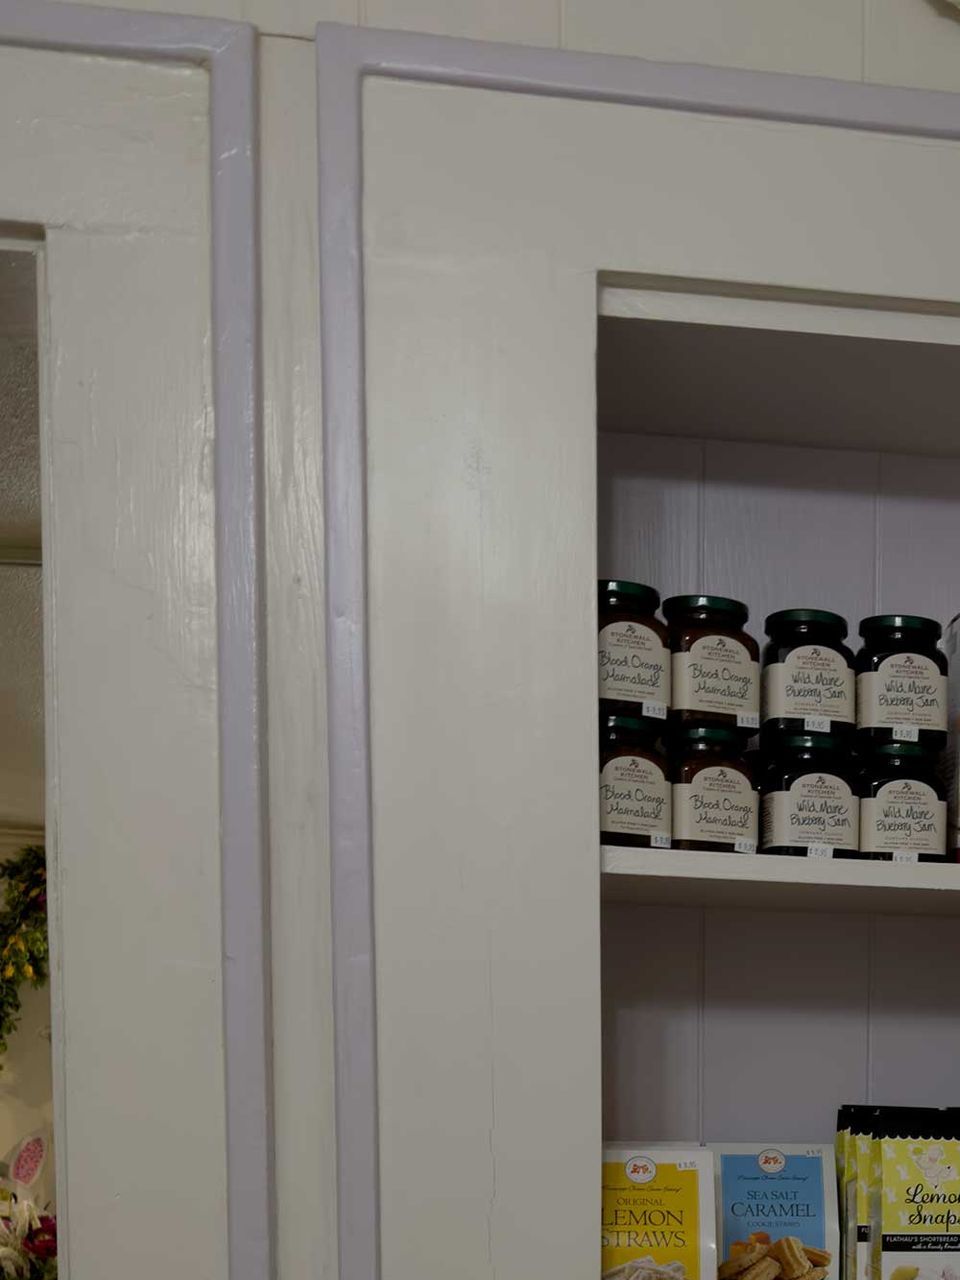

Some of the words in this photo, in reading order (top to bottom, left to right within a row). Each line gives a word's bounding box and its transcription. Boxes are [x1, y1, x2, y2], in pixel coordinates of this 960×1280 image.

[747, 1190, 769, 1200] SEA
[771, 1190, 800, 1200] SALT
[617, 1198, 664, 1206] ORIGINAL
[731, 1201, 816, 1217] CARAMEL
[601, 1208, 684, 1226] LEMON
